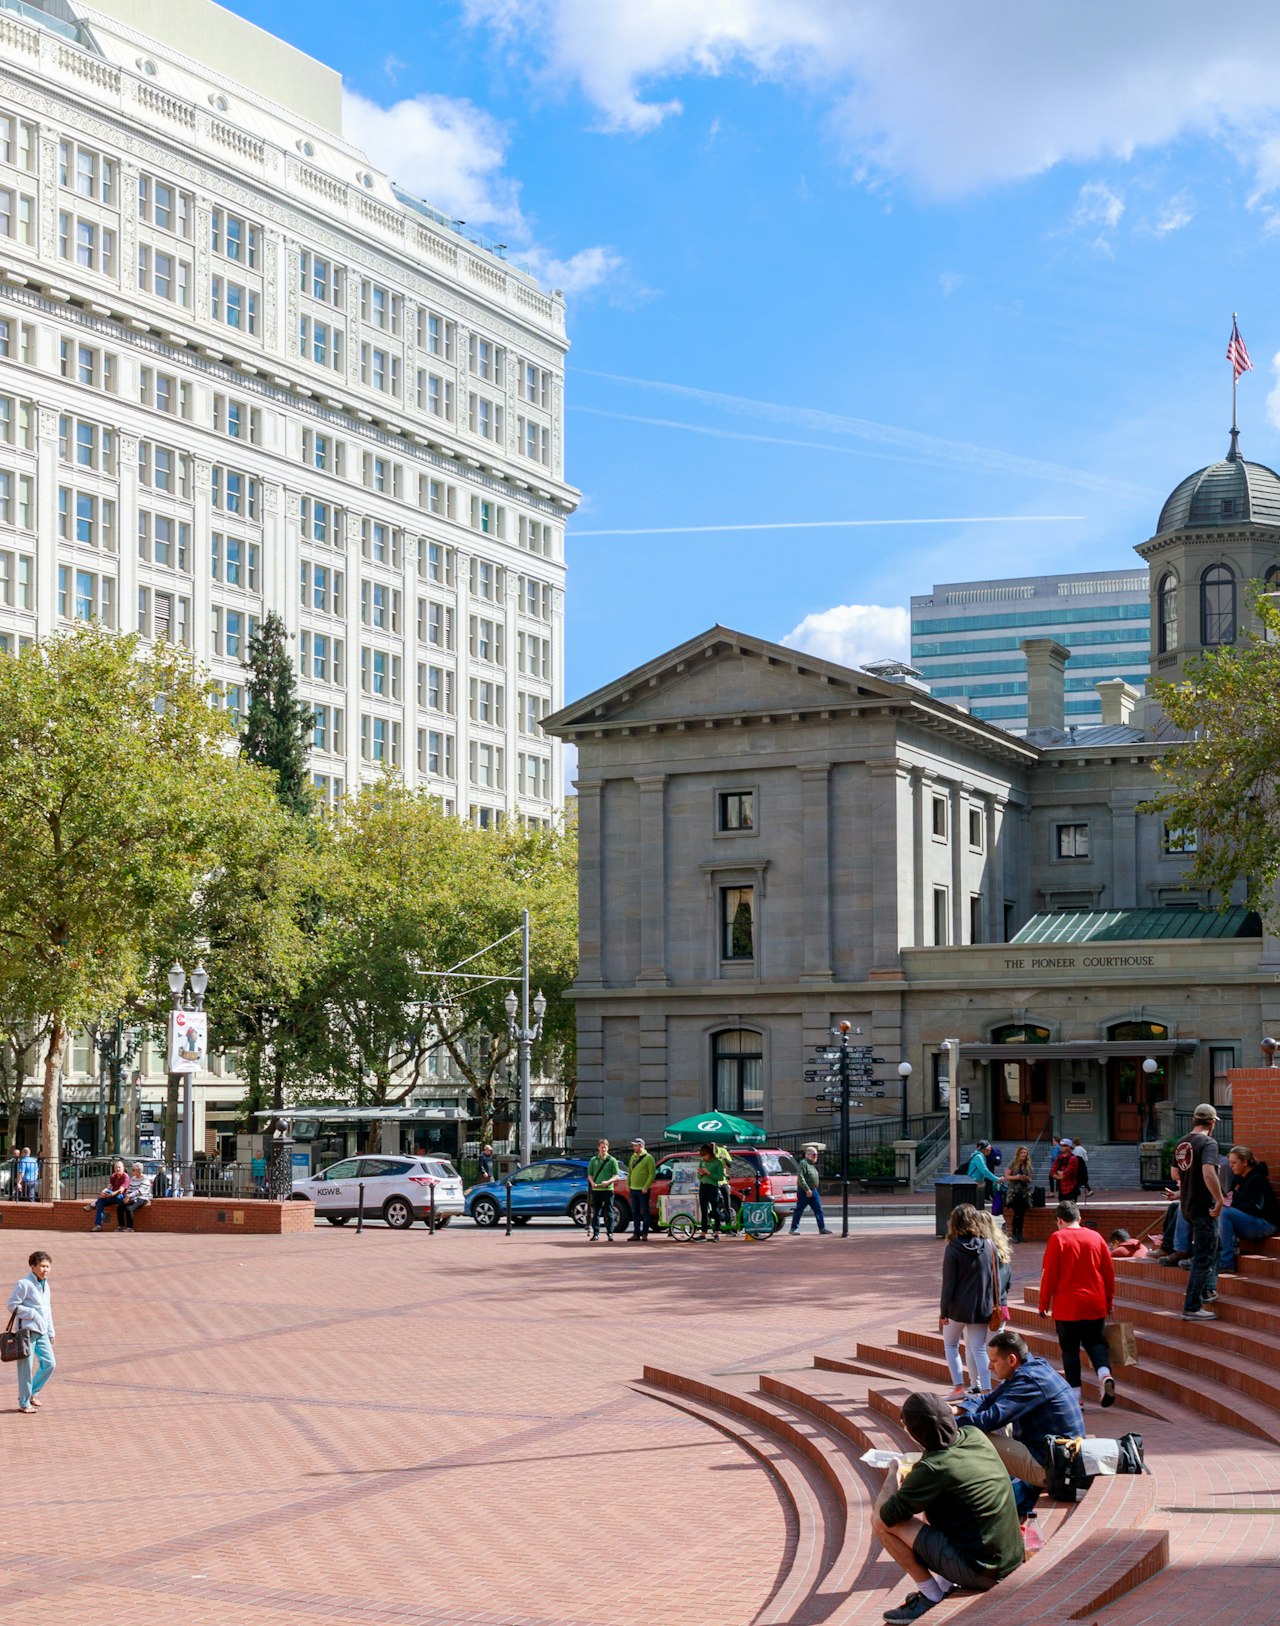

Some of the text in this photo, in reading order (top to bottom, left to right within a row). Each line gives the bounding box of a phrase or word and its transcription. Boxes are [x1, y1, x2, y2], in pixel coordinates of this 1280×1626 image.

[1005, 956, 1155, 969] THE PIONEER COURTHOUSE
